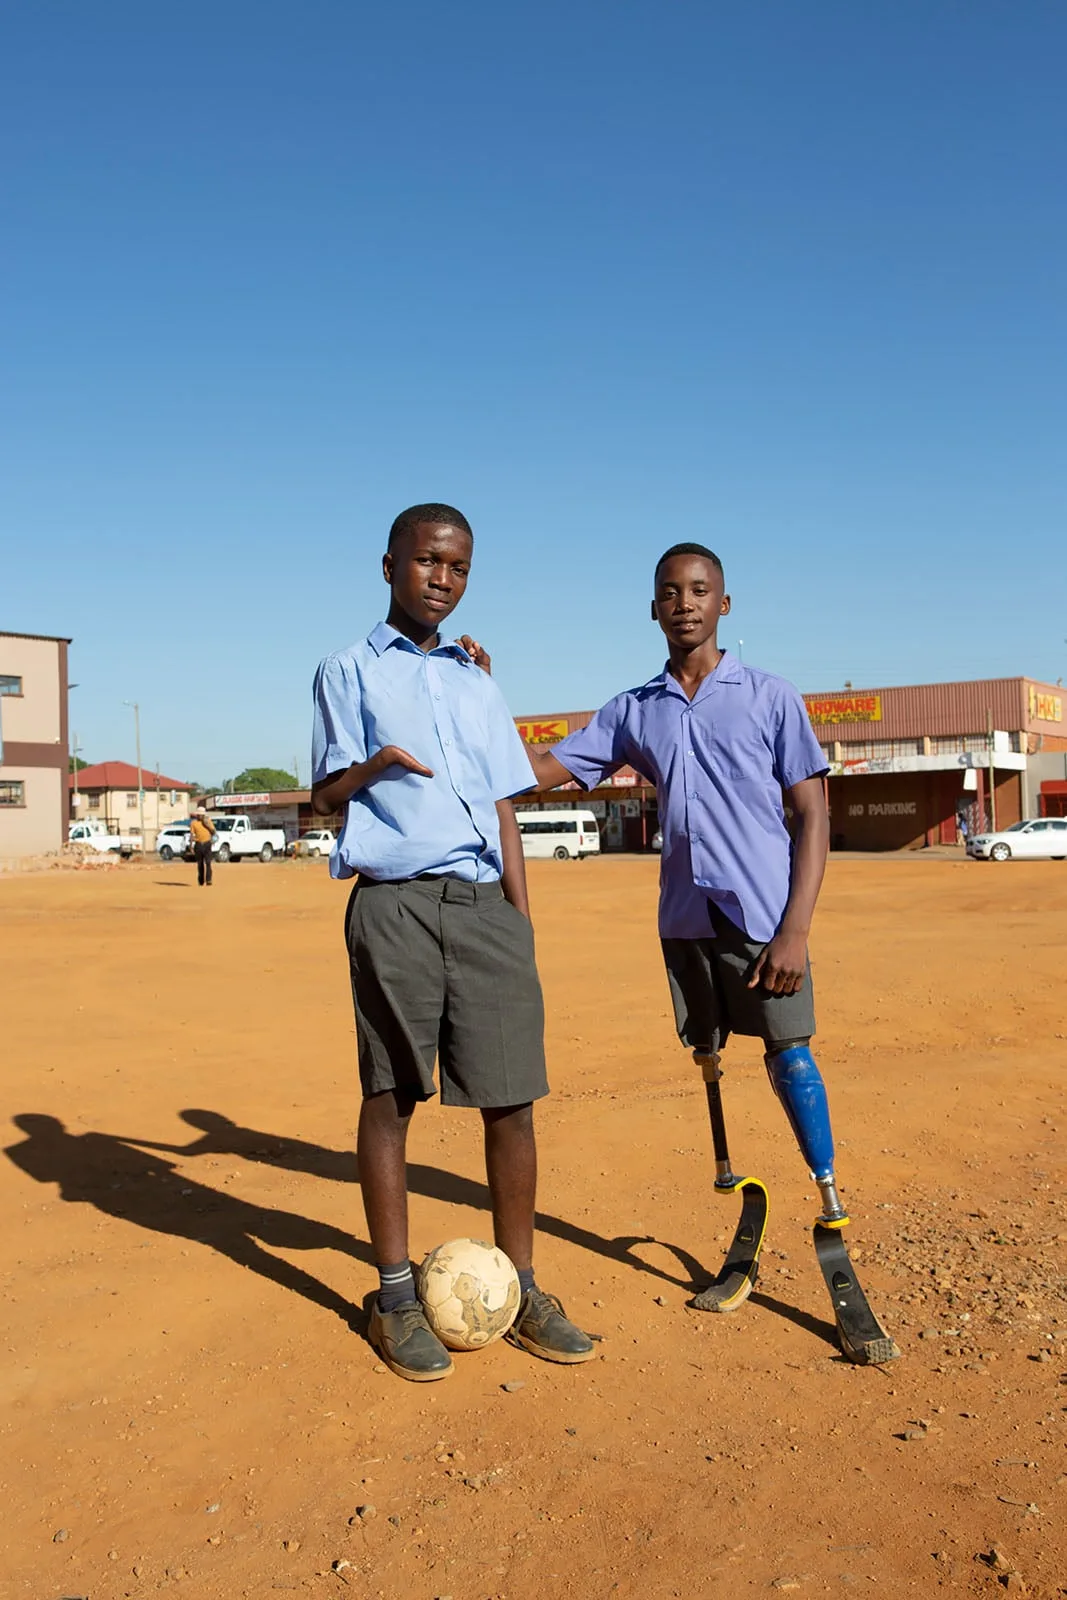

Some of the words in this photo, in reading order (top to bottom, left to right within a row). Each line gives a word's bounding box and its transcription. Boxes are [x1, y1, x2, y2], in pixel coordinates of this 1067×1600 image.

[805, 697, 876, 715] ARDWARE
[848, 804, 864, 816] NO
[868, 802, 916, 816] PARKING
